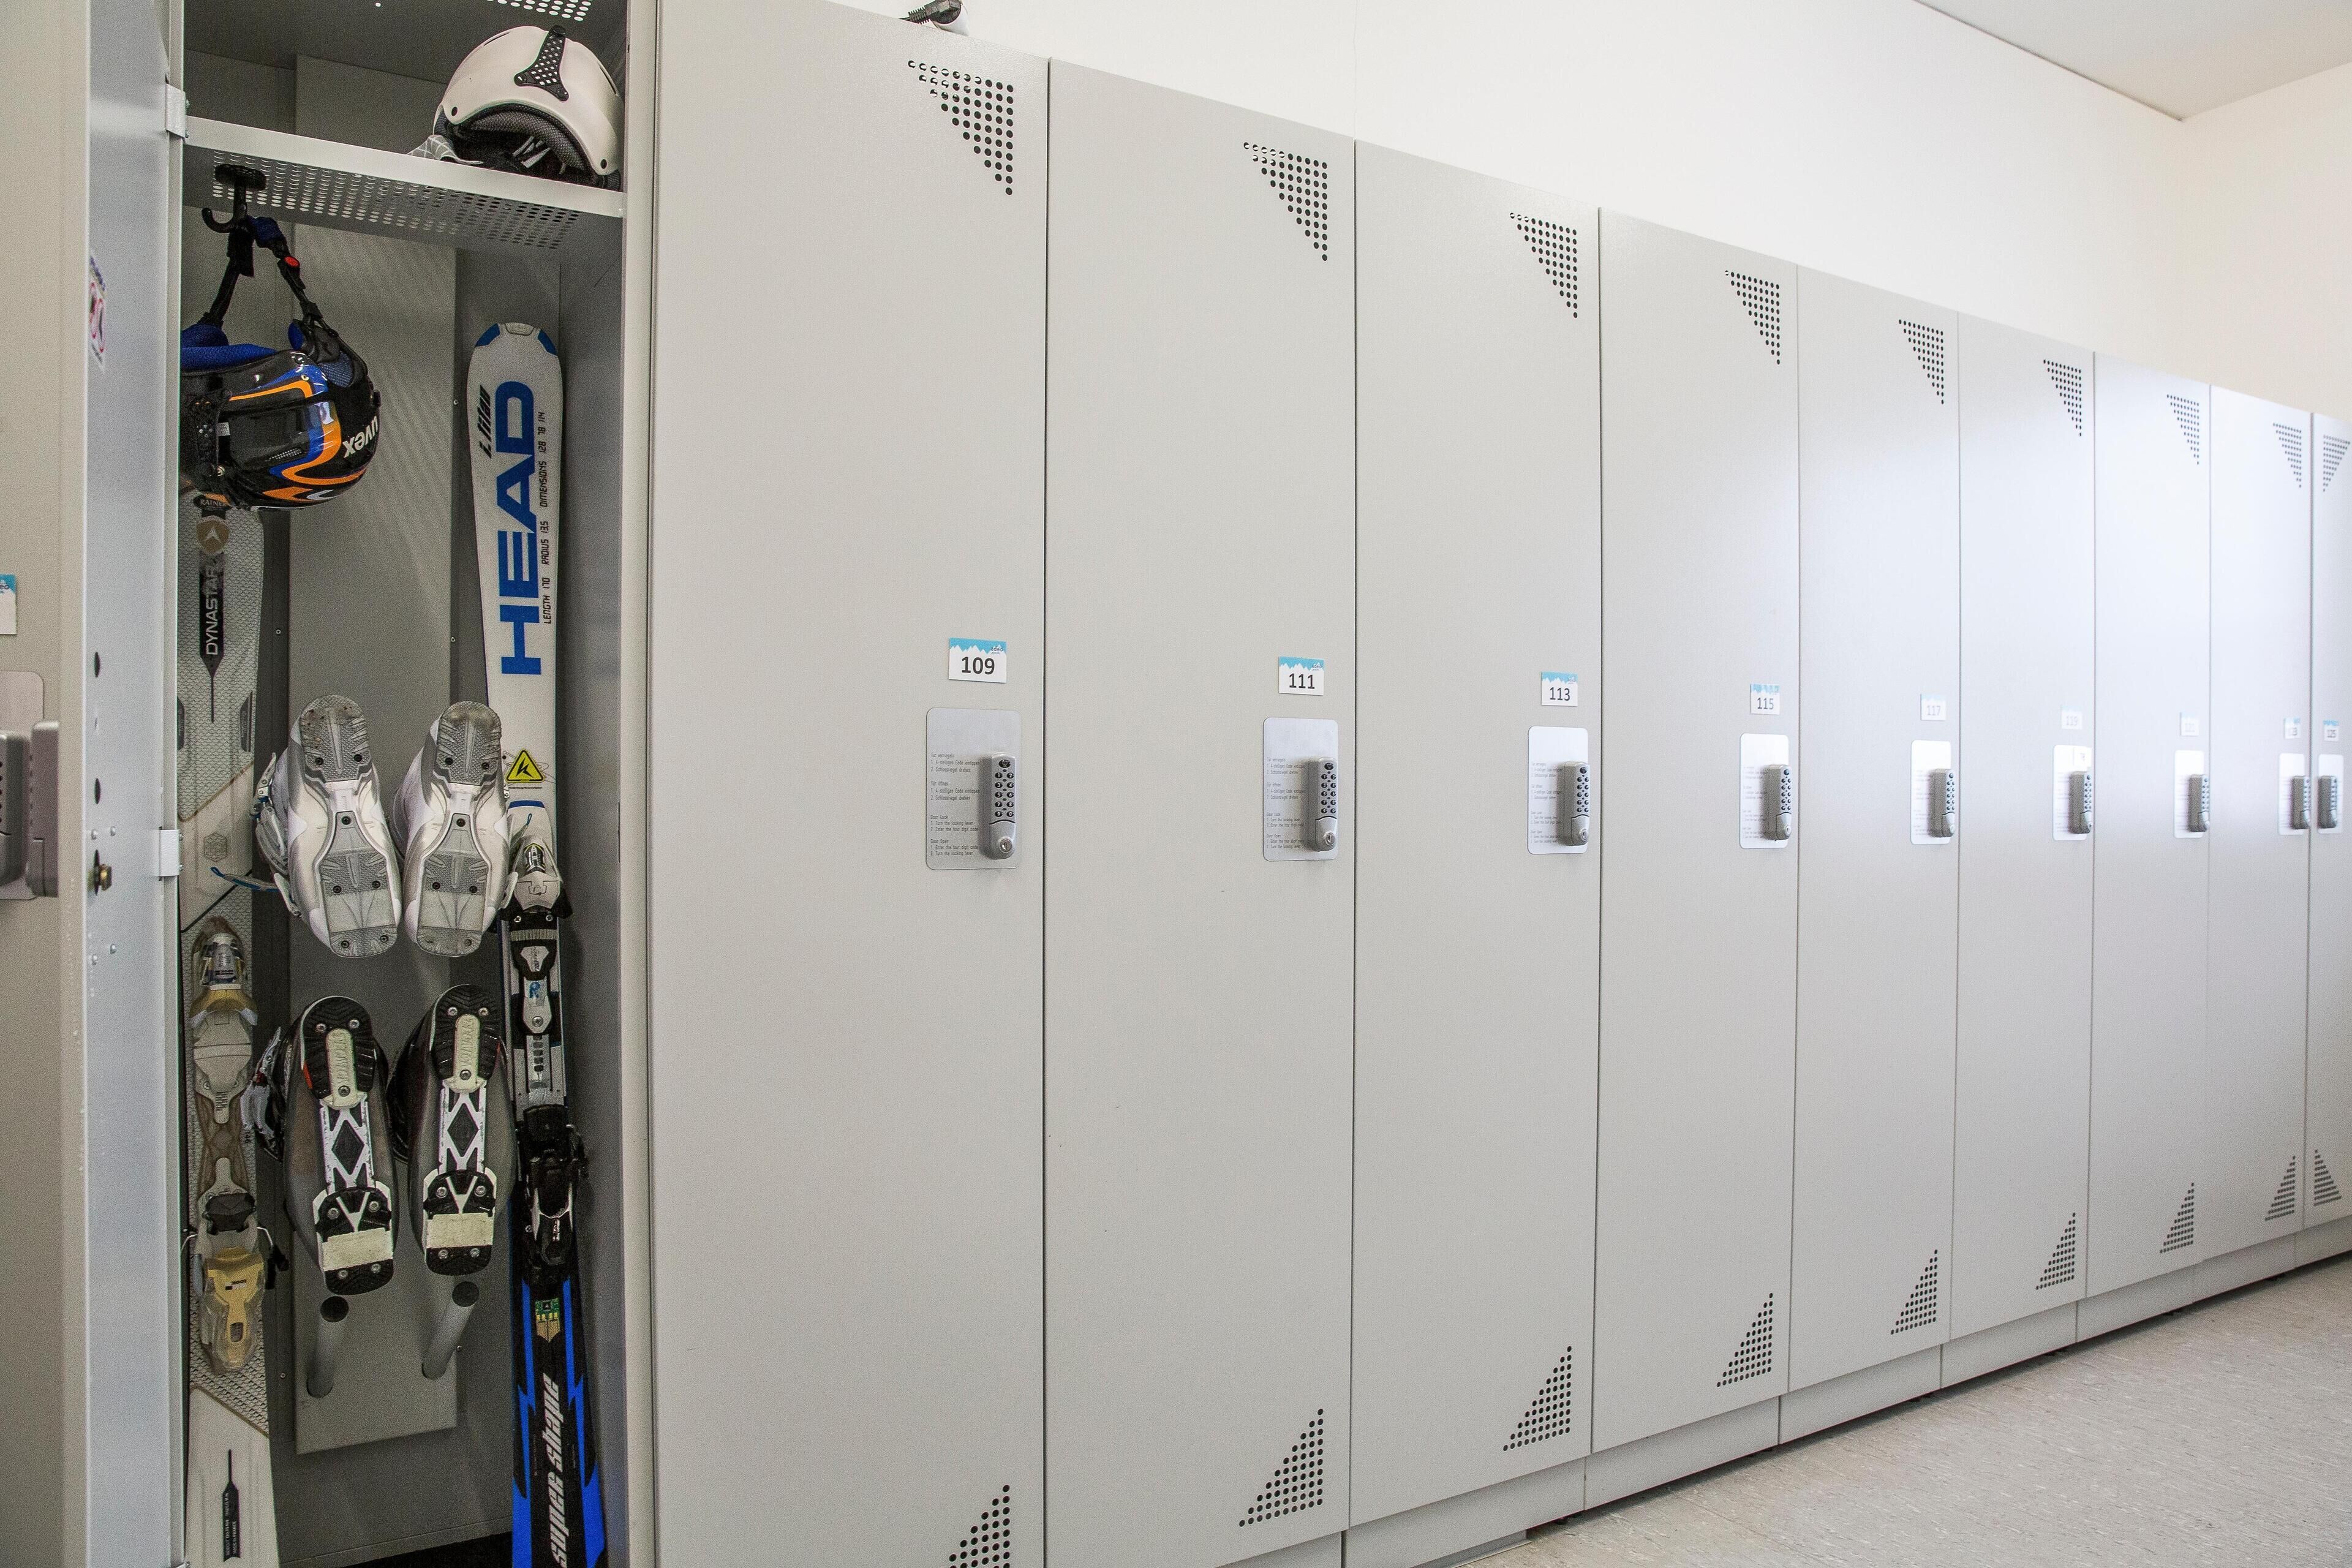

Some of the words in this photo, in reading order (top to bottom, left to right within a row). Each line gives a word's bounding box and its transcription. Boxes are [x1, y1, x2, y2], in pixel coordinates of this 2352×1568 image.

[342, 415, 378, 458] uvex
[538, 442, 547, 453] 128
[538, 461, 548, 507] DIMENSIONS
[495, 381, 541, 676] HEAD
[540, 539, 549, 565] RADIUS
[542, 578, 551, 589] 170
[542, 596, 551, 624] LENGTH
[962, 656, 995, 675] 109
[1289, 673, 1315, 689] 111
[1550, 687, 1570, 701] 113
[1757, 698, 1774, 710] 115
[1926, 705, 1941, 716] 117
[541, 1373, 564, 1472] shape
[547, 1471, 570, 1568] super
